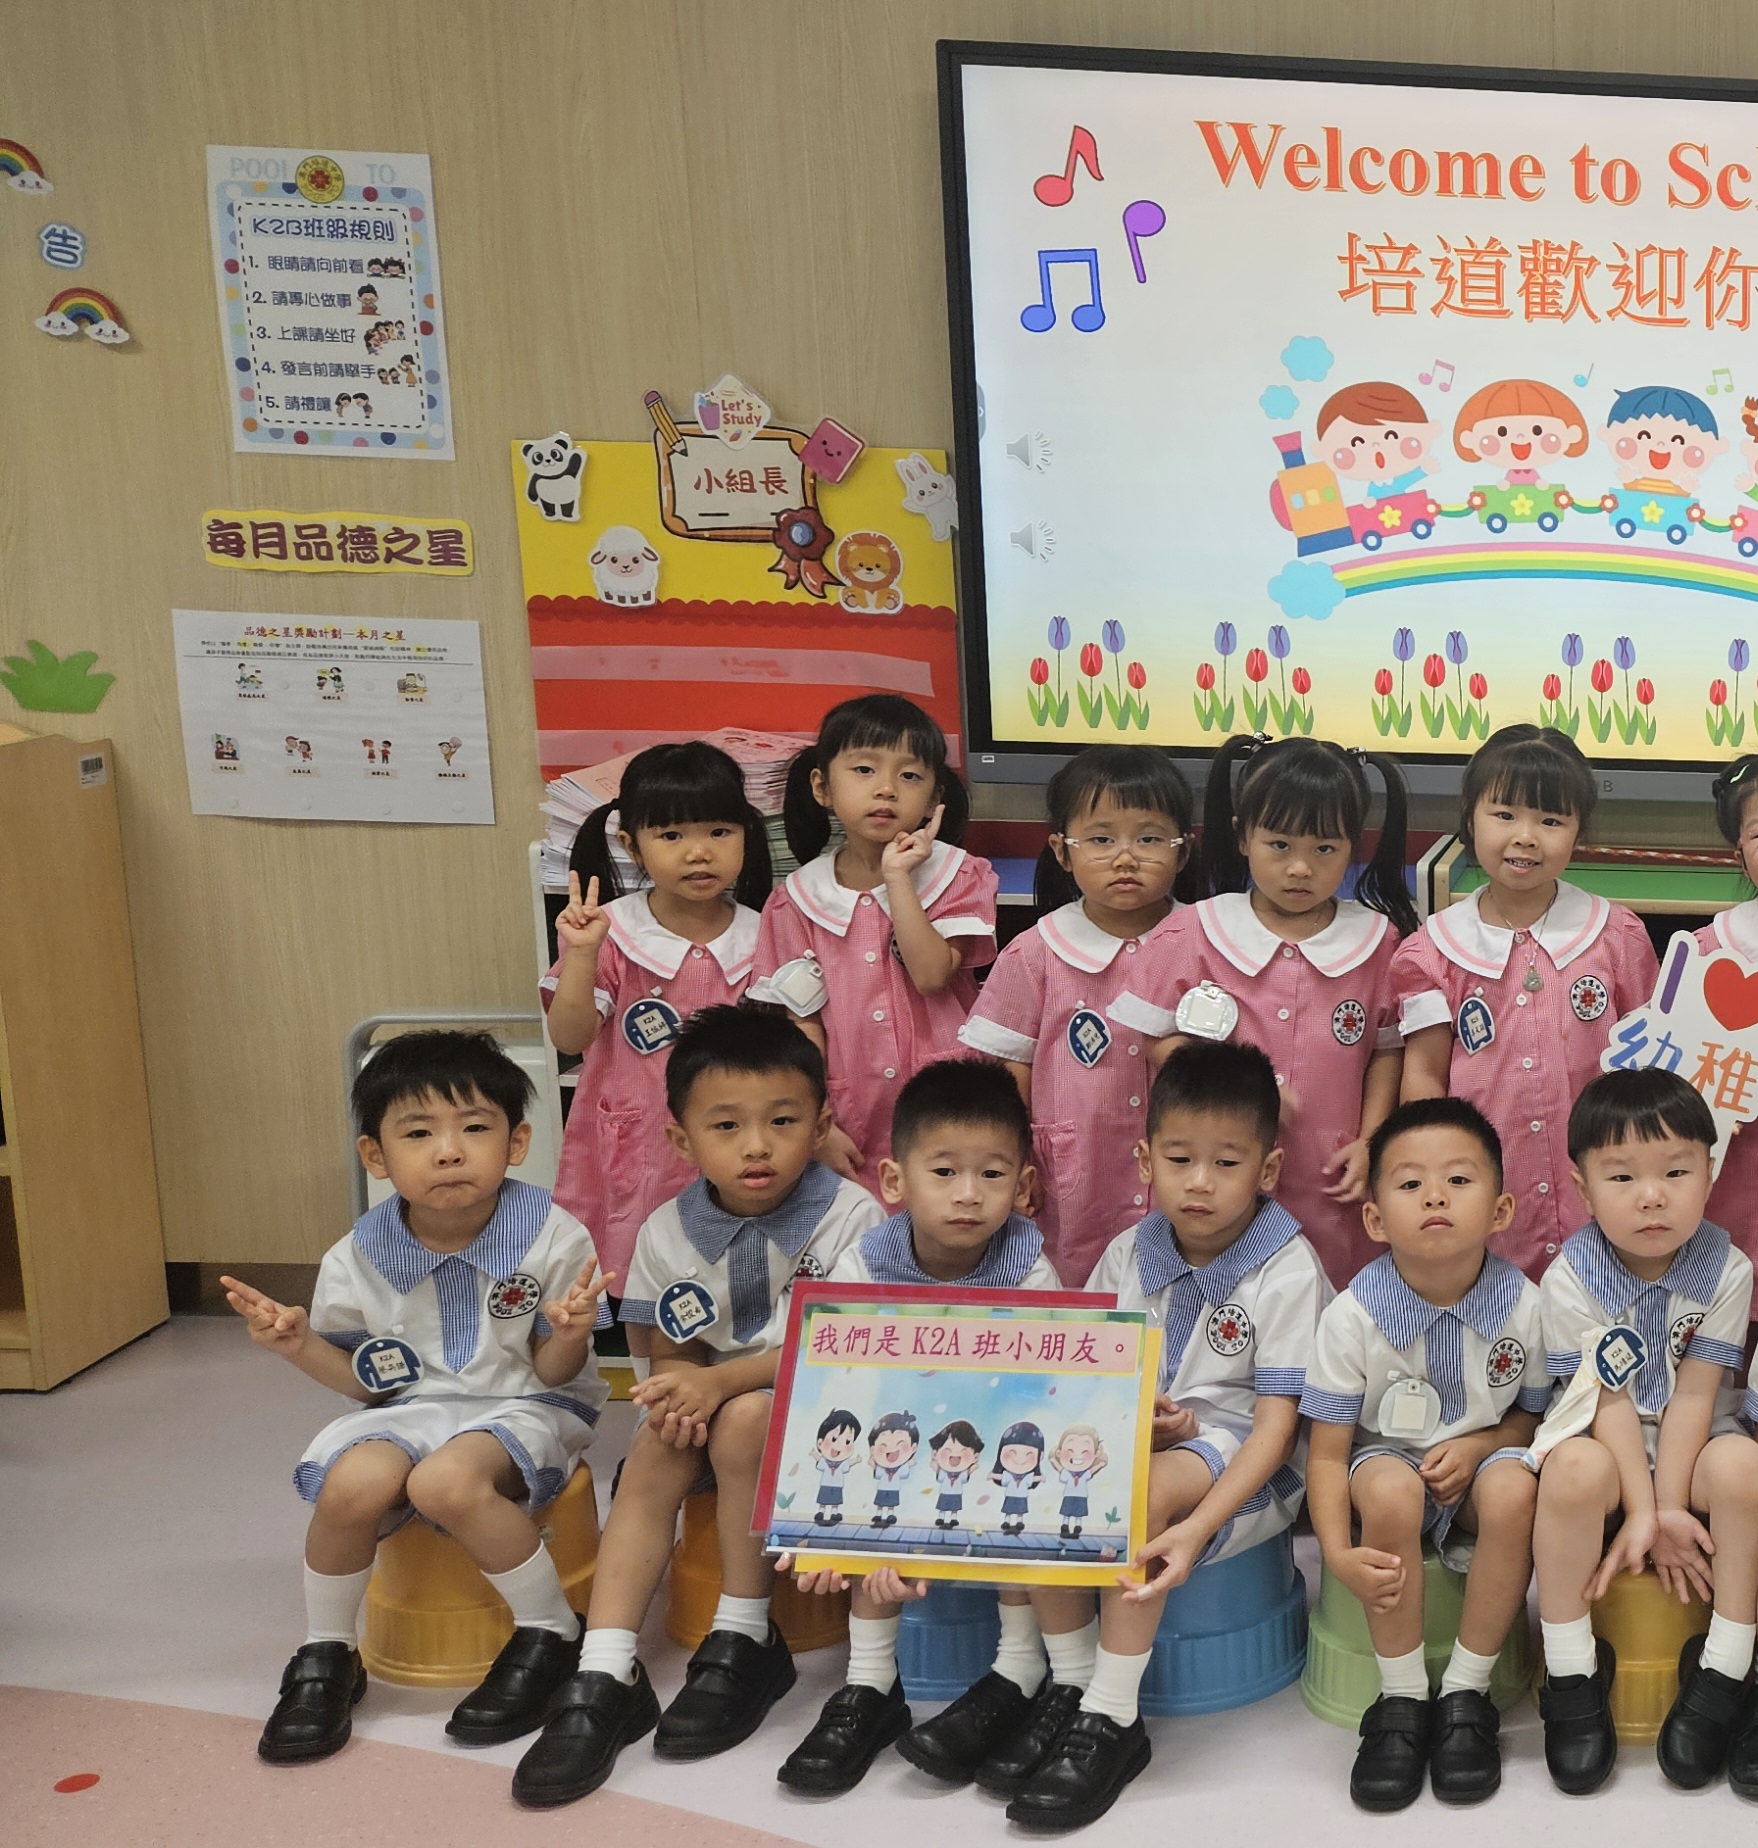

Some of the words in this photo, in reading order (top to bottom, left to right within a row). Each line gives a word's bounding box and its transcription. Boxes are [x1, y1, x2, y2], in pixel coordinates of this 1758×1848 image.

[1194, 119, 1546, 201] Welcome
[1571, 142, 1642, 207] to
[39, 223, 86, 270] 告
[252, 290, 267, 304] 2.
[256, 326, 272, 339] 3.
[277, 325, 357, 343] 上課請坐好
[261, 361, 276, 374] 4.
[265, 396, 280, 409] 5.
[721, 398, 754, 414] Let's
[722, 412, 763, 428] Study
[694, 465, 789, 496] 小組長
[205, 518, 468, 568] 每月品德之星
[812, 1322, 902, 1357] 我們是
[911, 1324, 963, 1357] K2A
[970, 1329, 1126, 1364] 班小朋友。
